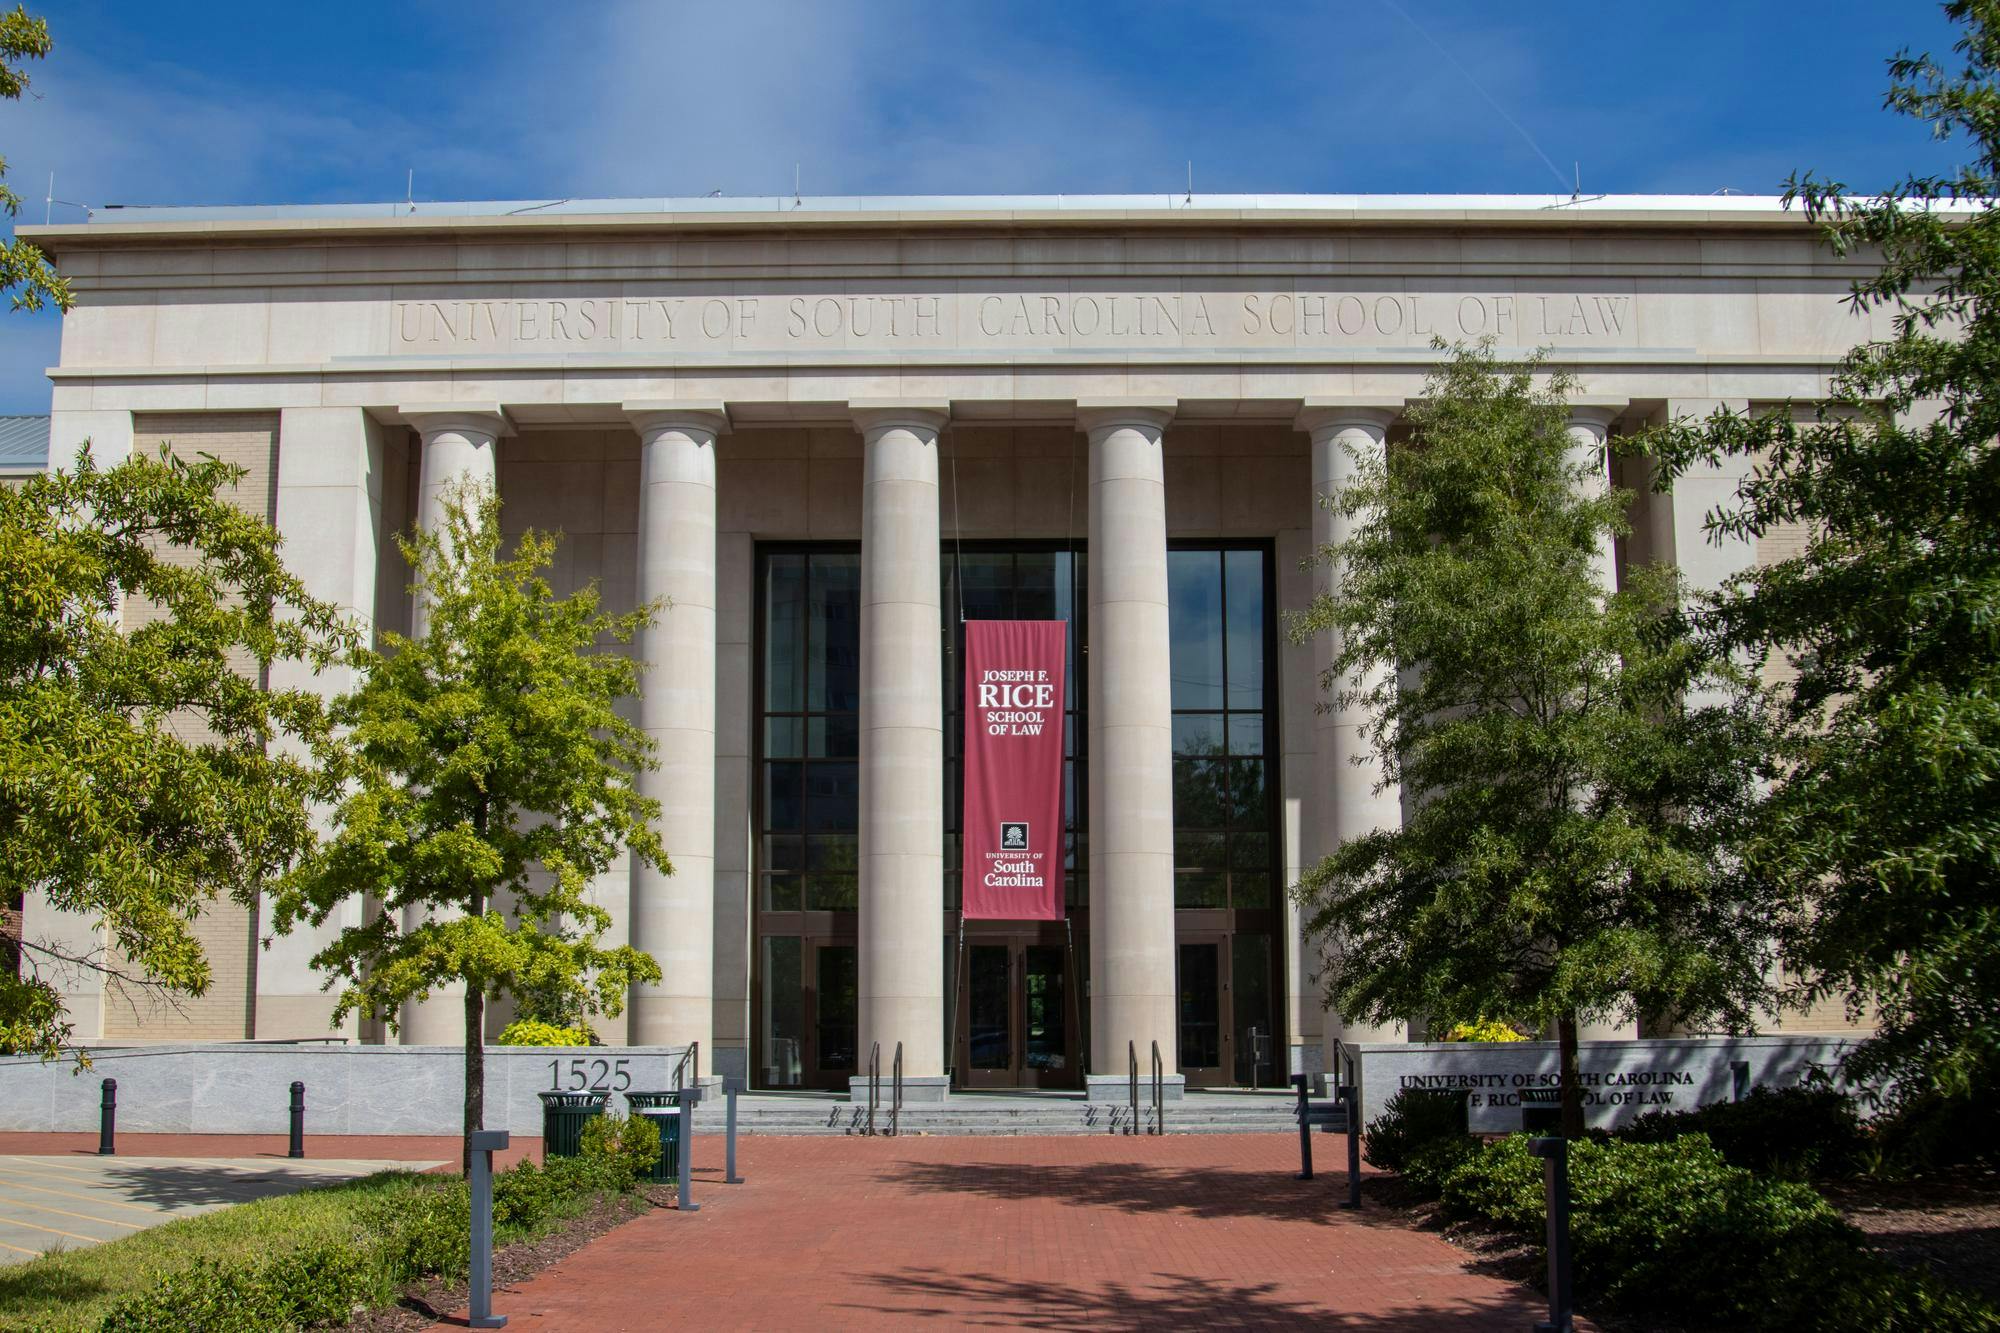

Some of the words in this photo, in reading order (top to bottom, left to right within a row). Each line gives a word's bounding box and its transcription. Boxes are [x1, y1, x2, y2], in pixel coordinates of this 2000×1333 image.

[396, 299, 685, 342] UNIVERSITY
[702, 298, 759, 339] OF
[787, 297, 942, 338] SOUTH
[977, 295, 1217, 336] CAROLINA
[1242, 294, 1434, 336] SCHOOL
[1456, 295, 1516, 336] OF
[1536, 295, 1631, 336] LAW
[983, 670, 1035, 684] JOSEPH
[1038, 670, 1049, 682] F.
[978, 684, 1054, 708] RICE
[987, 711, 1045, 723] SCHOOL
[988, 724, 1008, 736] OF
[1011, 724, 1042, 736] LAW
[986, 852, 1031, 860] UNIVERSITY
[1033, 852, 1043, 860] OF
[993, 860, 1035, 873] South
[984, 873, 1044, 887] Carolina
[547, 1058, 632, 1092] 1525
[1400, 1074, 1508, 1088] UNIVERSITY
[1512, 1074, 1535, 1087] OF
[1540, 1073, 1600, 1087] SOTH
[1605, 1071, 1695, 1086] CAROLINA
[1471, 1094, 1483, 1107] F.
[1488, 1093, 1522, 1107] RIC
[1610, 1092, 1633, 1105] OF
[1638, 1091, 1674, 1105] LAW
